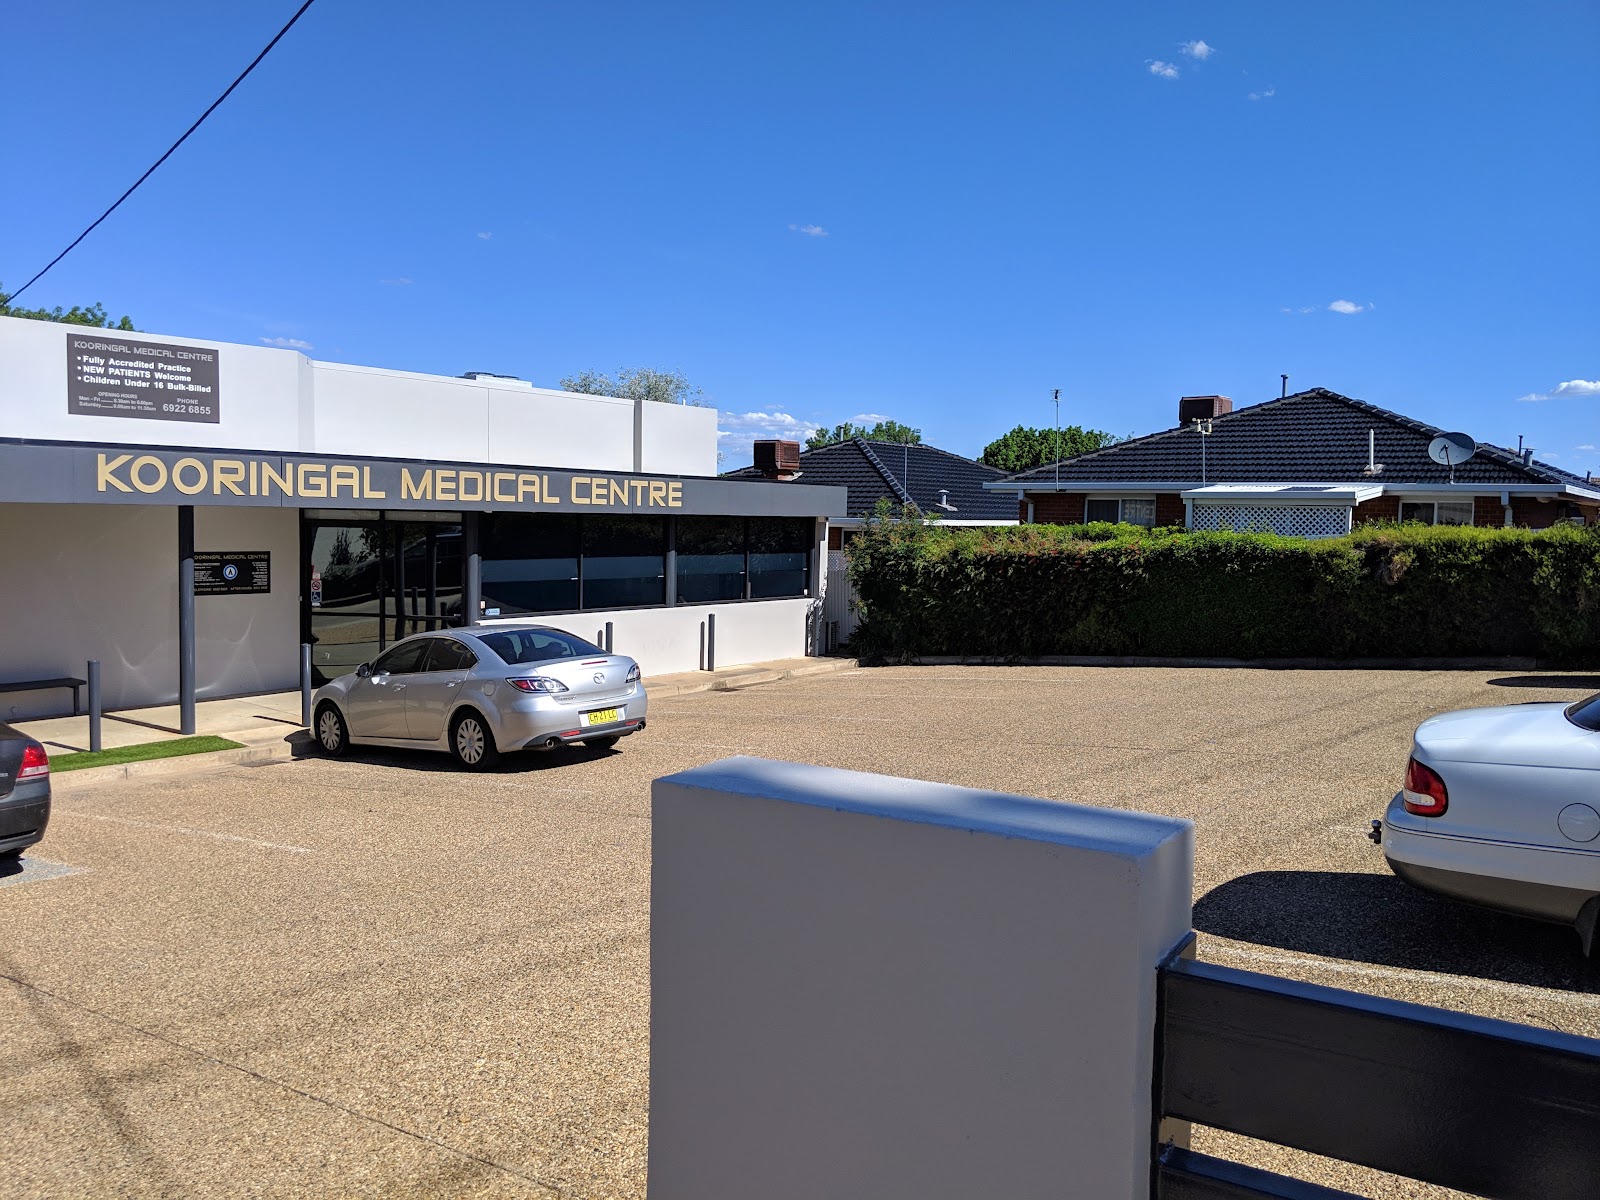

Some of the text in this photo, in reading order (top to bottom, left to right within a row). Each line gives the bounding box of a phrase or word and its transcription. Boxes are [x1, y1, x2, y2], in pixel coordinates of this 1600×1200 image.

[74, 341, 213, 362] KOORINGAL MEDICAL CENTRE
[83, 355, 192, 373] Fully Accredited Practice
[83, 365, 192, 382] NEW PATIENTS Welcome
[83, 375, 121, 385] Children
[124, 379, 150, 388] Under
[167, 383, 211, 393] Bulk-Billed
[163, 403, 211, 414] 6922 6855
[97, 453, 683, 507] KOORINGAL MEDICAL CENTRE
